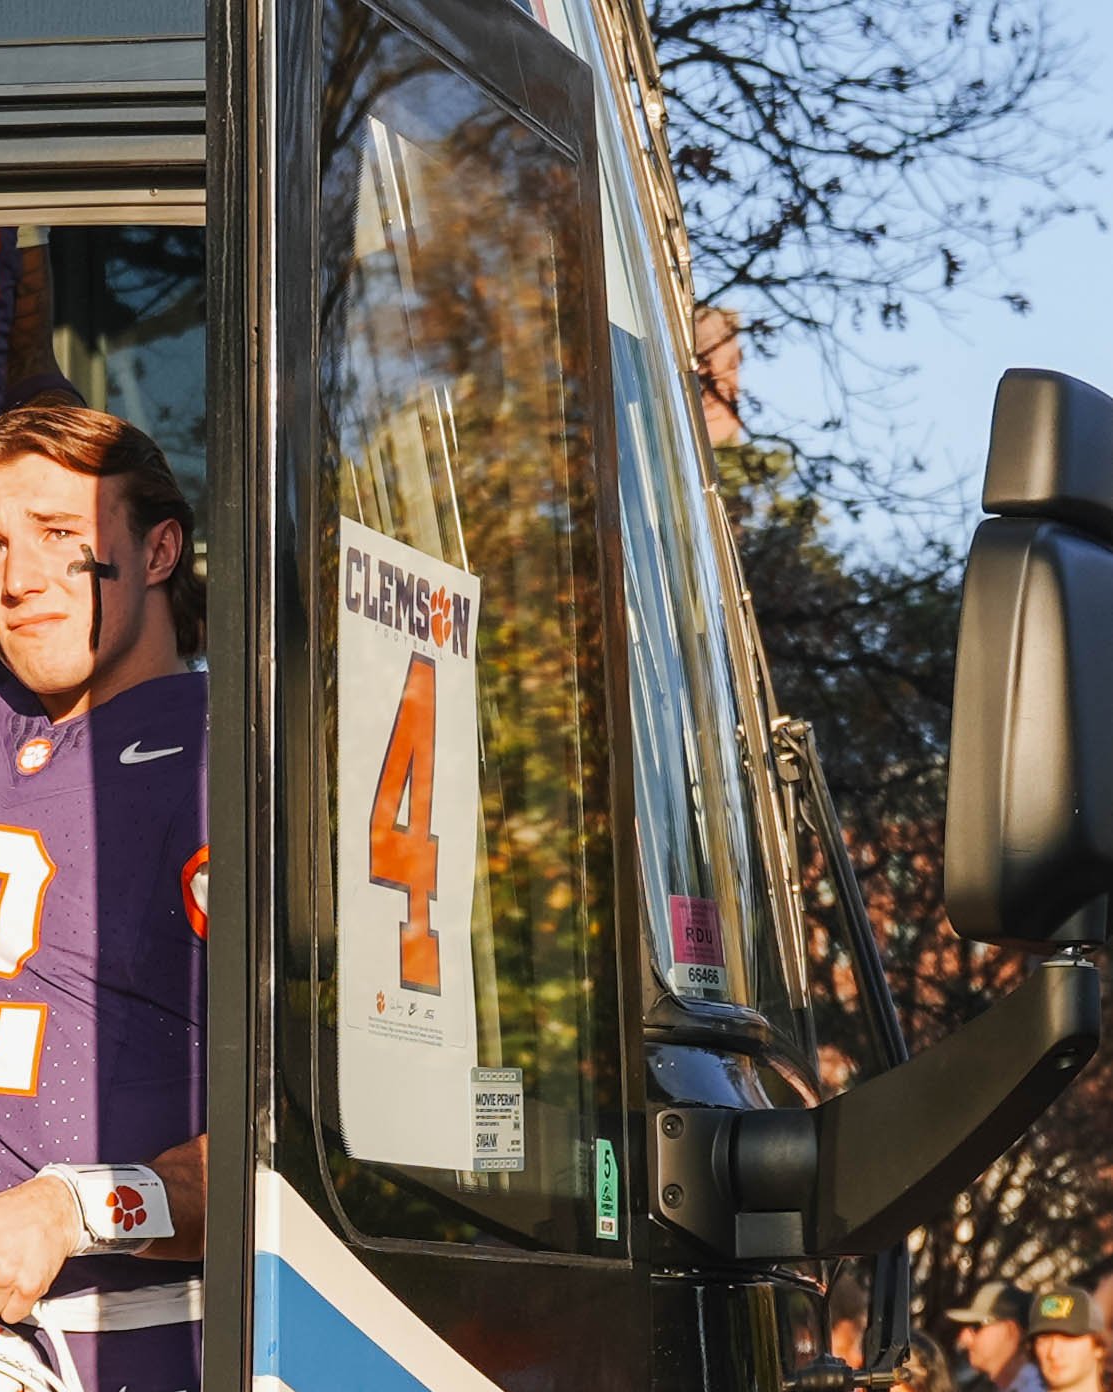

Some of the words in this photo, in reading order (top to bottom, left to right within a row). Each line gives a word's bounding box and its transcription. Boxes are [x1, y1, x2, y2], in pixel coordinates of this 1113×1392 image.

[369, 651, 441, 996] 4
[685, 926, 713, 945] RDU
[688, 967, 720, 985] 66466
[475, 1093, 496, 1106] MOVIE
[497, 1093, 521, 1107] PERMIT
